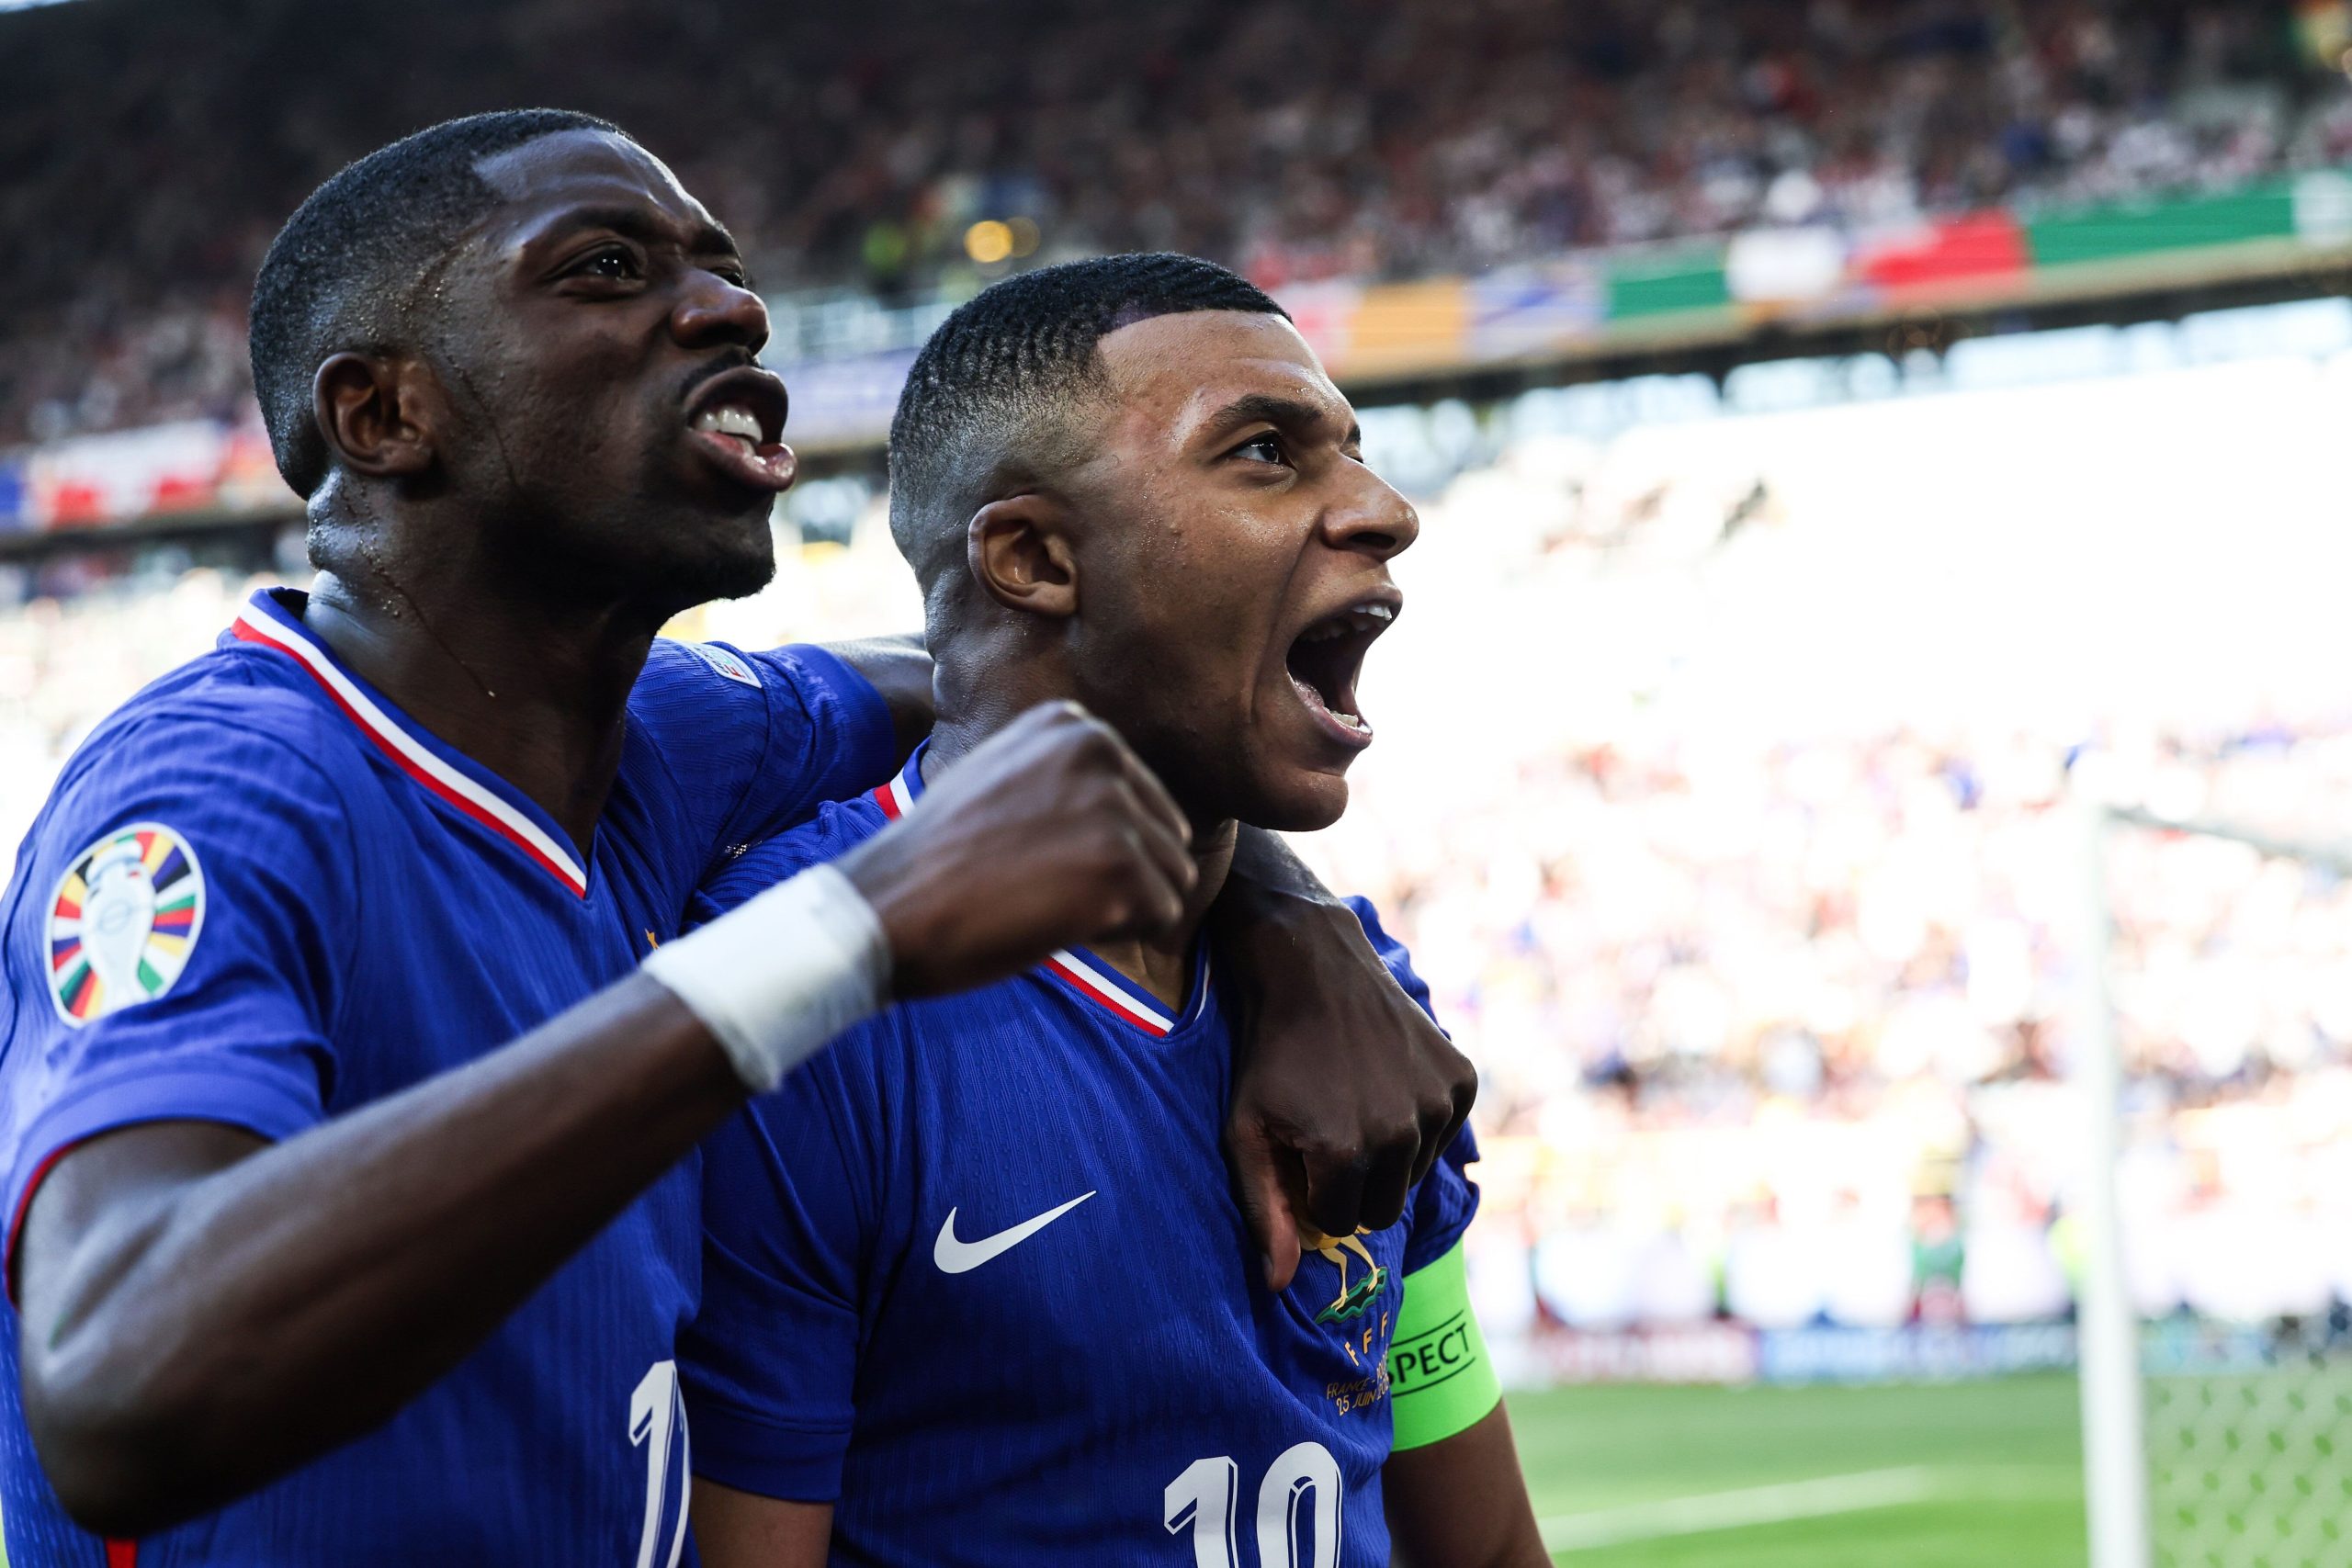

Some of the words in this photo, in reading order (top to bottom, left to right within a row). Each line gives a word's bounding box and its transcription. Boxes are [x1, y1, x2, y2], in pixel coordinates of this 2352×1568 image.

[1387, 1322, 1469, 1385] PECT
[1327, 1377, 1370, 1401] FRANCE
[1336, 1394, 1350, 1416] 25
[1351, 1388, 1377, 1409] JUIN
[1164, 1441, 1342, 1568] 10
